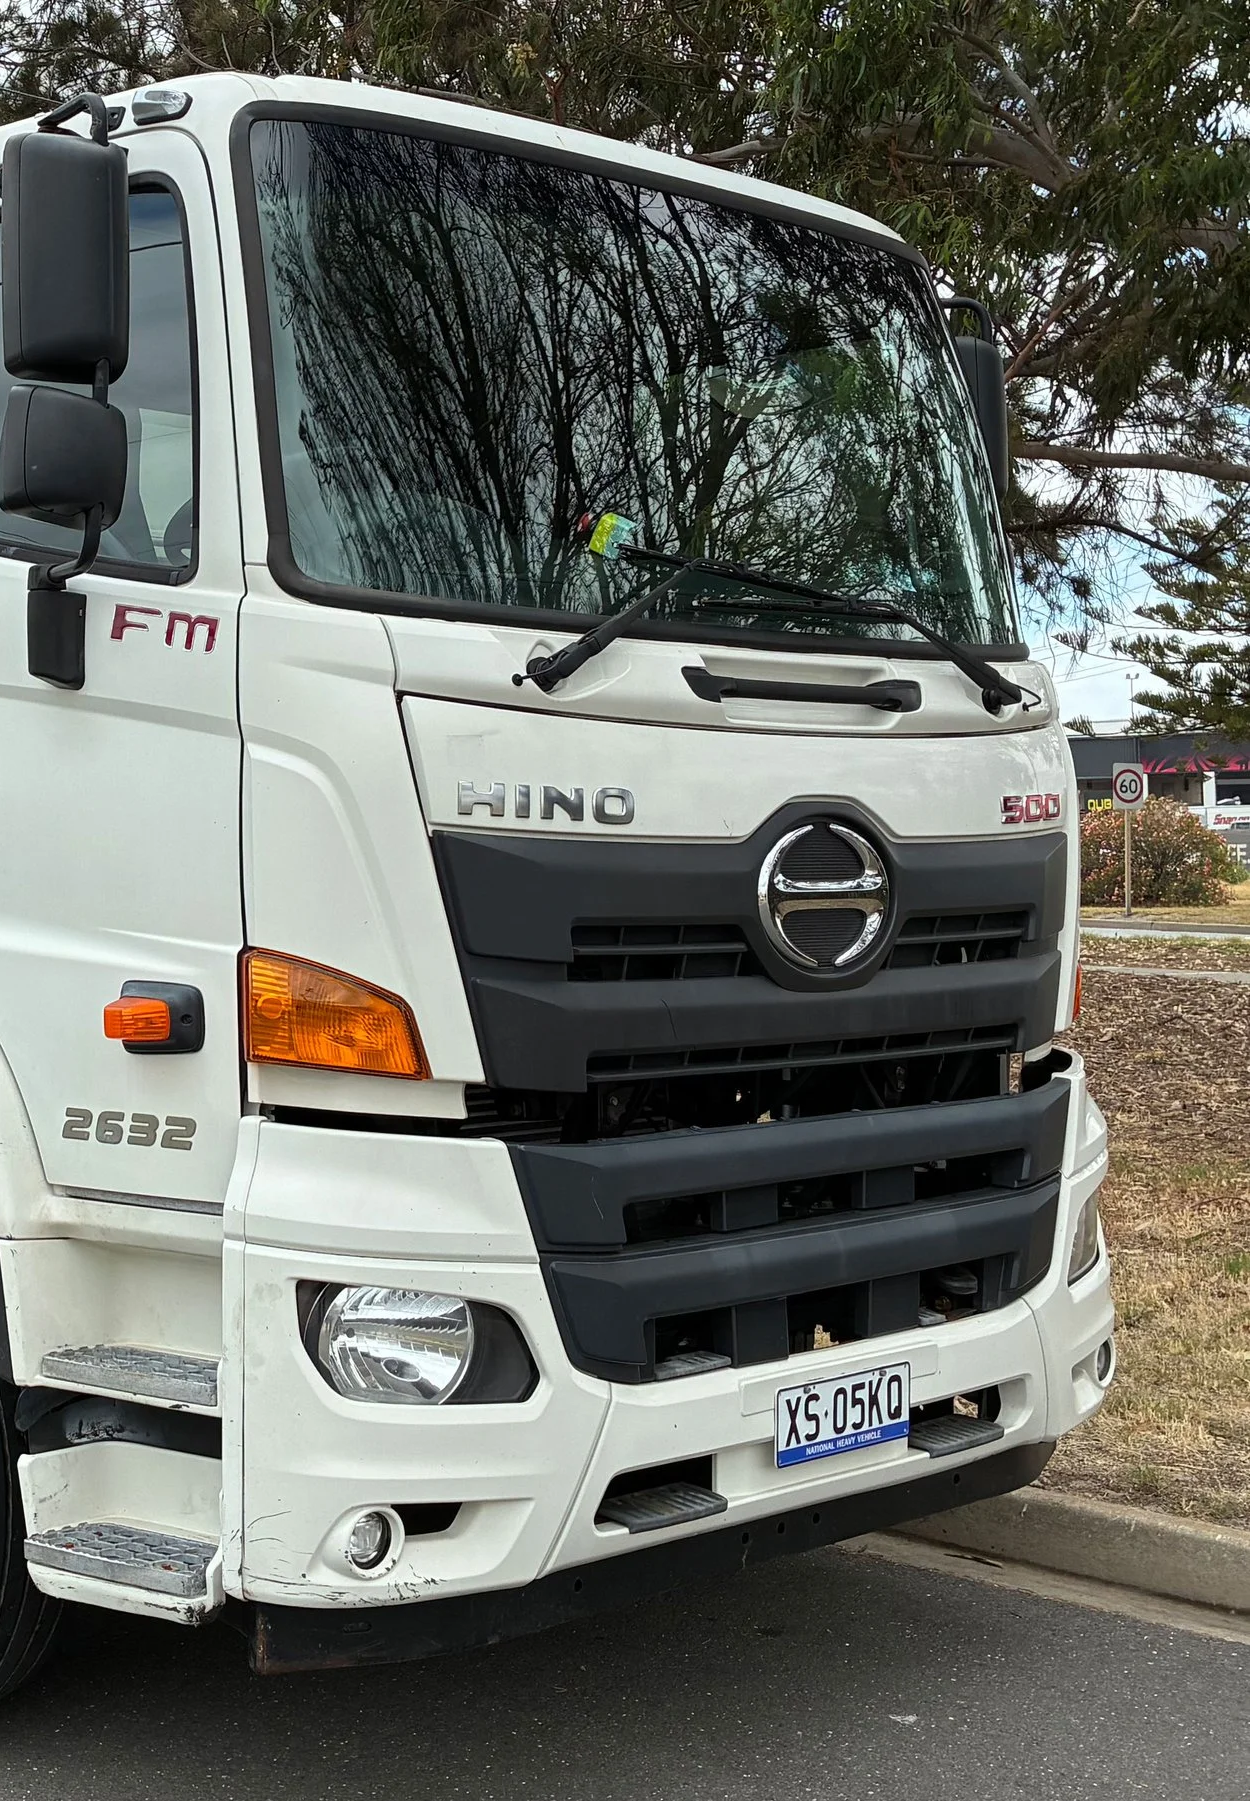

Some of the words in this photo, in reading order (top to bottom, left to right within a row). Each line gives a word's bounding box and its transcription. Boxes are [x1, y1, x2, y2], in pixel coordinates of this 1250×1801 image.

[1119, 778, 1138, 794] 60
[457, 780, 635, 825] HINO
[1000, 793, 1060, 824] 500
[1087, 798, 1114, 811] QUB
[62, 1107, 197, 1150] 2632
[805, 1442, 836, 1456] NATIONAL
[836, 1436, 856, 1449] HEAVY
[856, 1429, 882, 1443] VEHICLE
